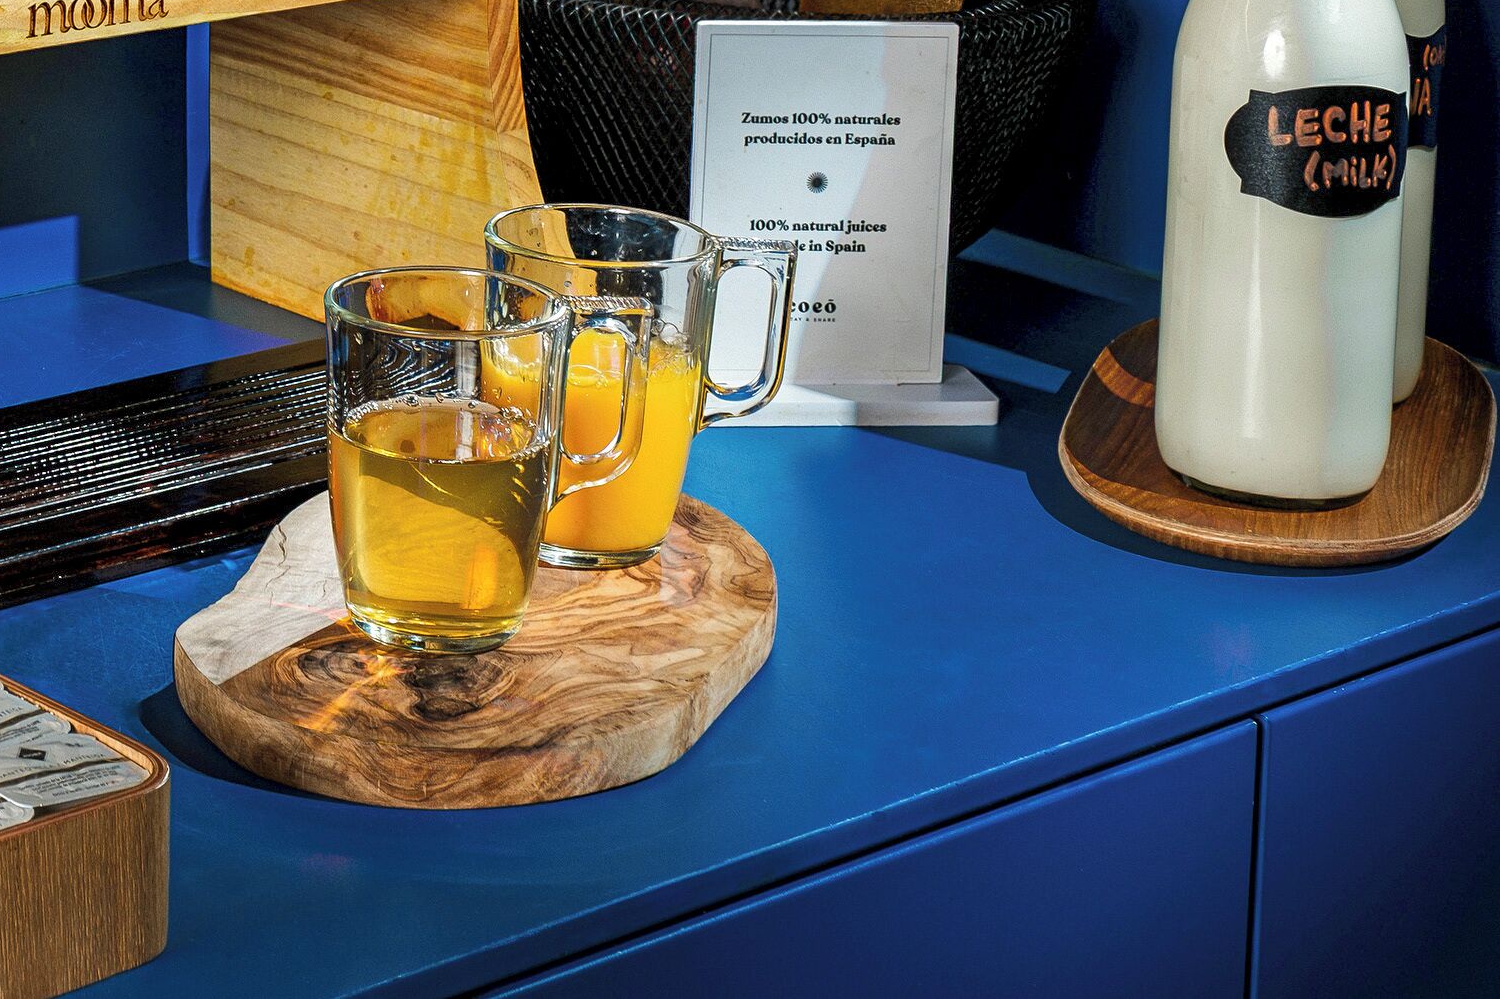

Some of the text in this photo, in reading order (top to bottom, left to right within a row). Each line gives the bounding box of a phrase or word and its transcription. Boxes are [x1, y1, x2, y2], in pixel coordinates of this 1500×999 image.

[741, 112, 901, 126] Zumos 100% naturales
[1268, 100, 1393, 147] LECHE
[744, 132, 896, 148] producidos en España
[749, 219, 887, 235] 100% natural juices
[808, 239, 823, 252] in
[825, 240, 866, 255] Spain
